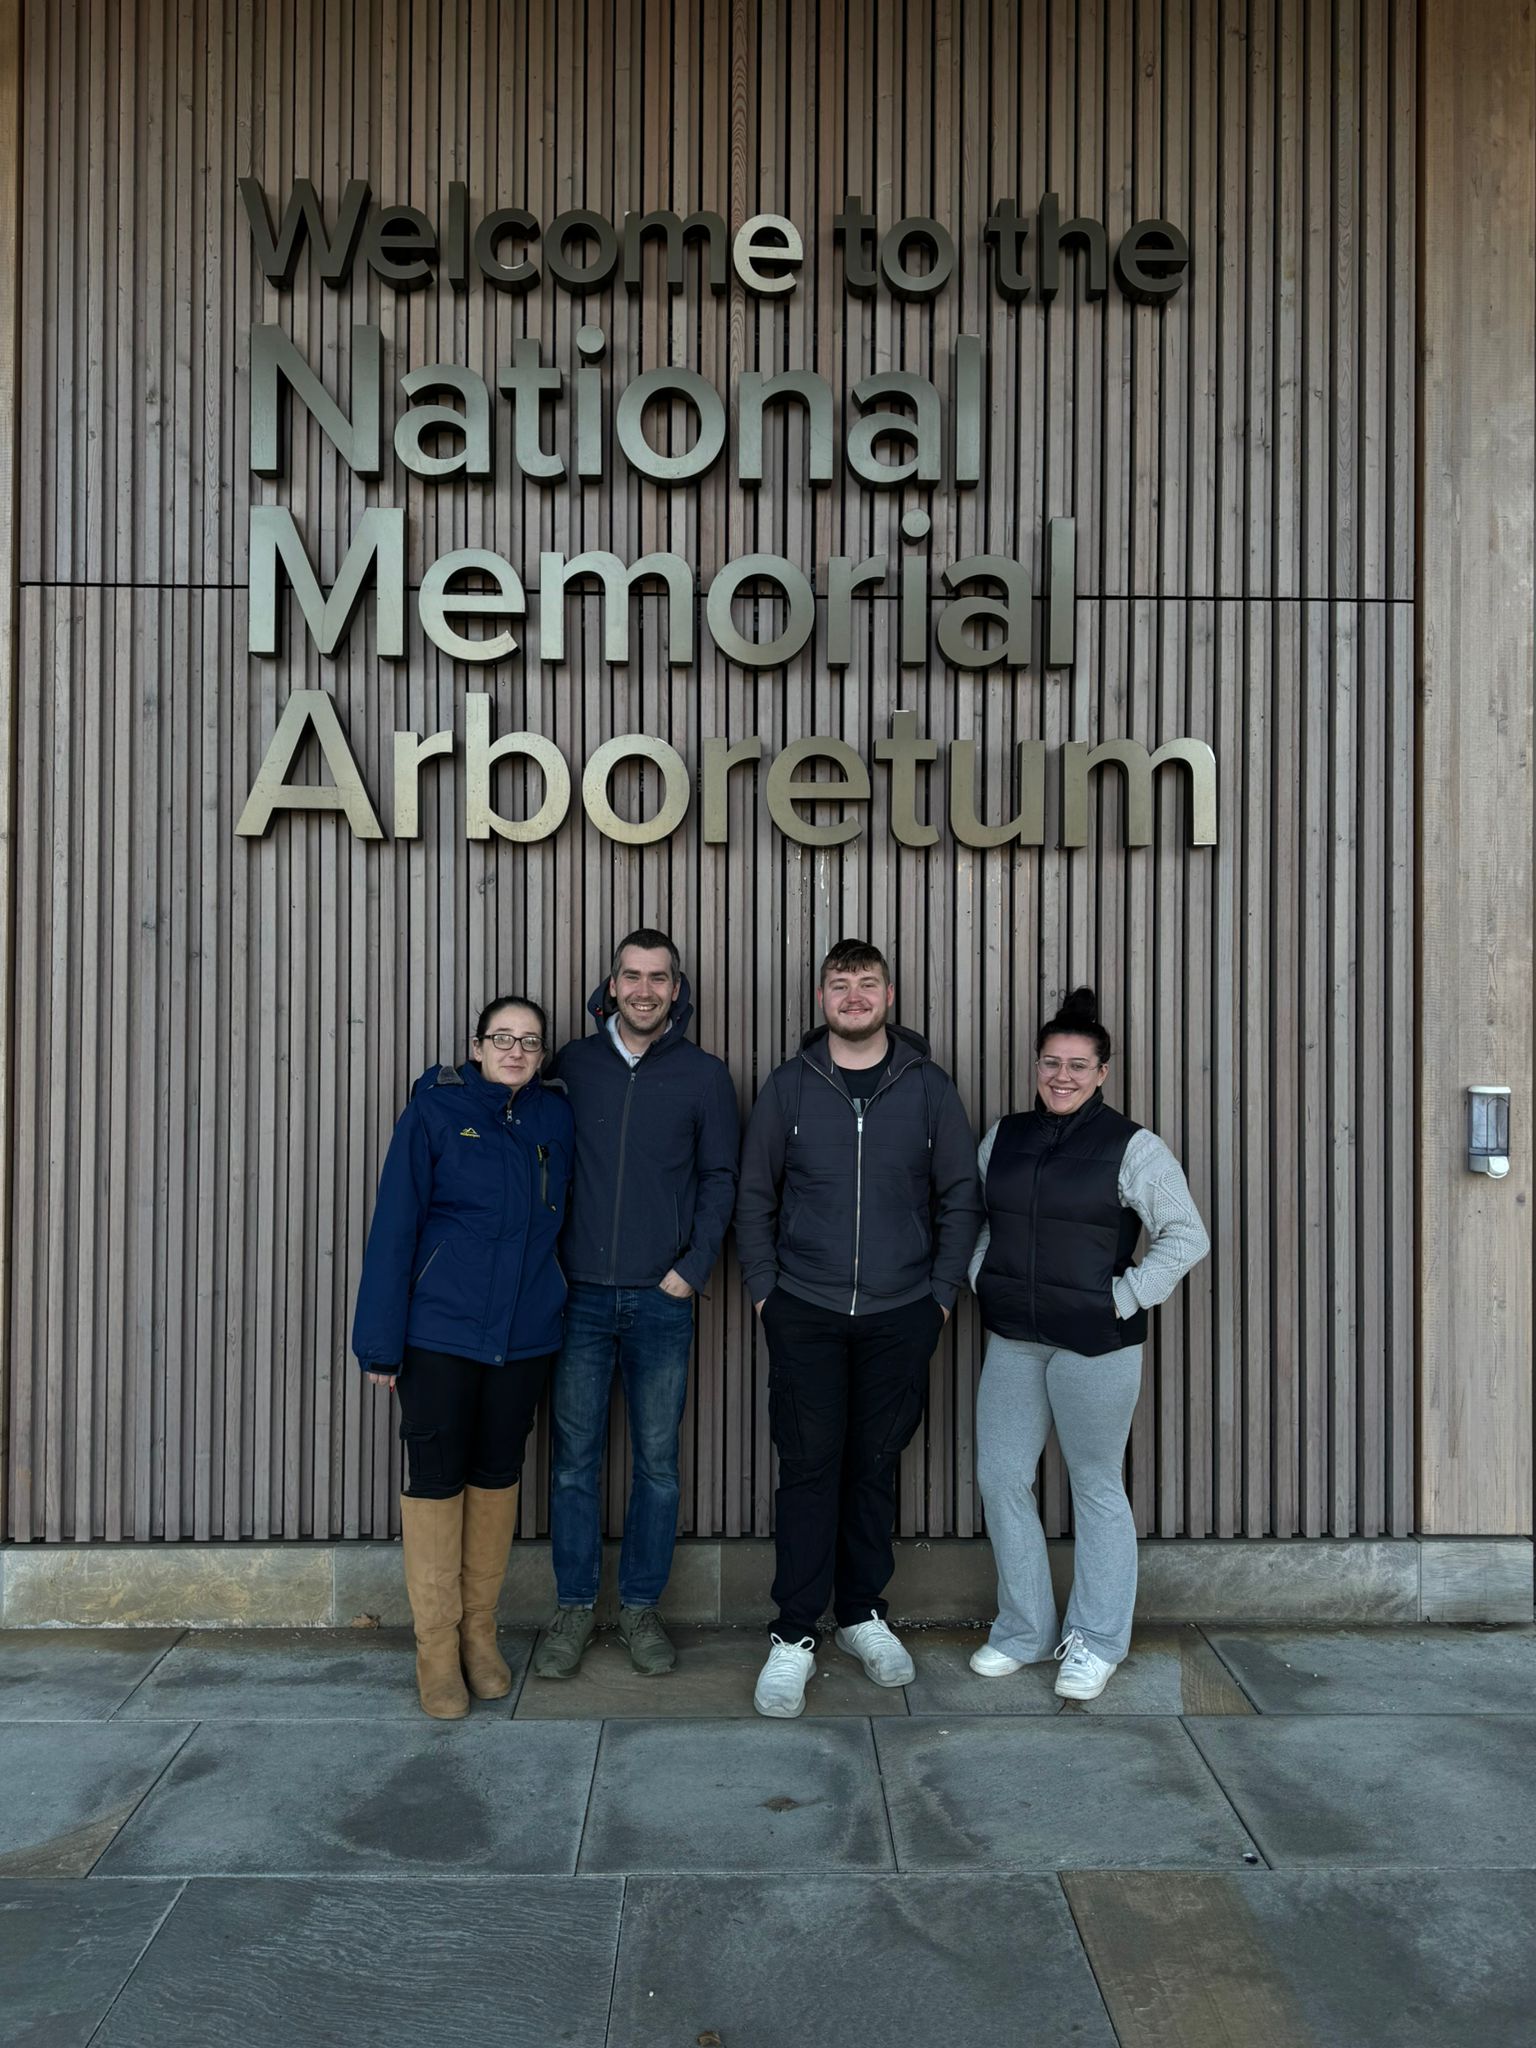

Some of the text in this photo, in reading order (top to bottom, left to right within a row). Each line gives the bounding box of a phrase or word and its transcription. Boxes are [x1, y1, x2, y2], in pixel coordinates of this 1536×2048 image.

[238, 177, 1189, 302] Welcome to the
[250, 323, 980, 487] National
[248, 504, 1076, 669] Memorial
[234, 689, 1217, 850] Arboretum
